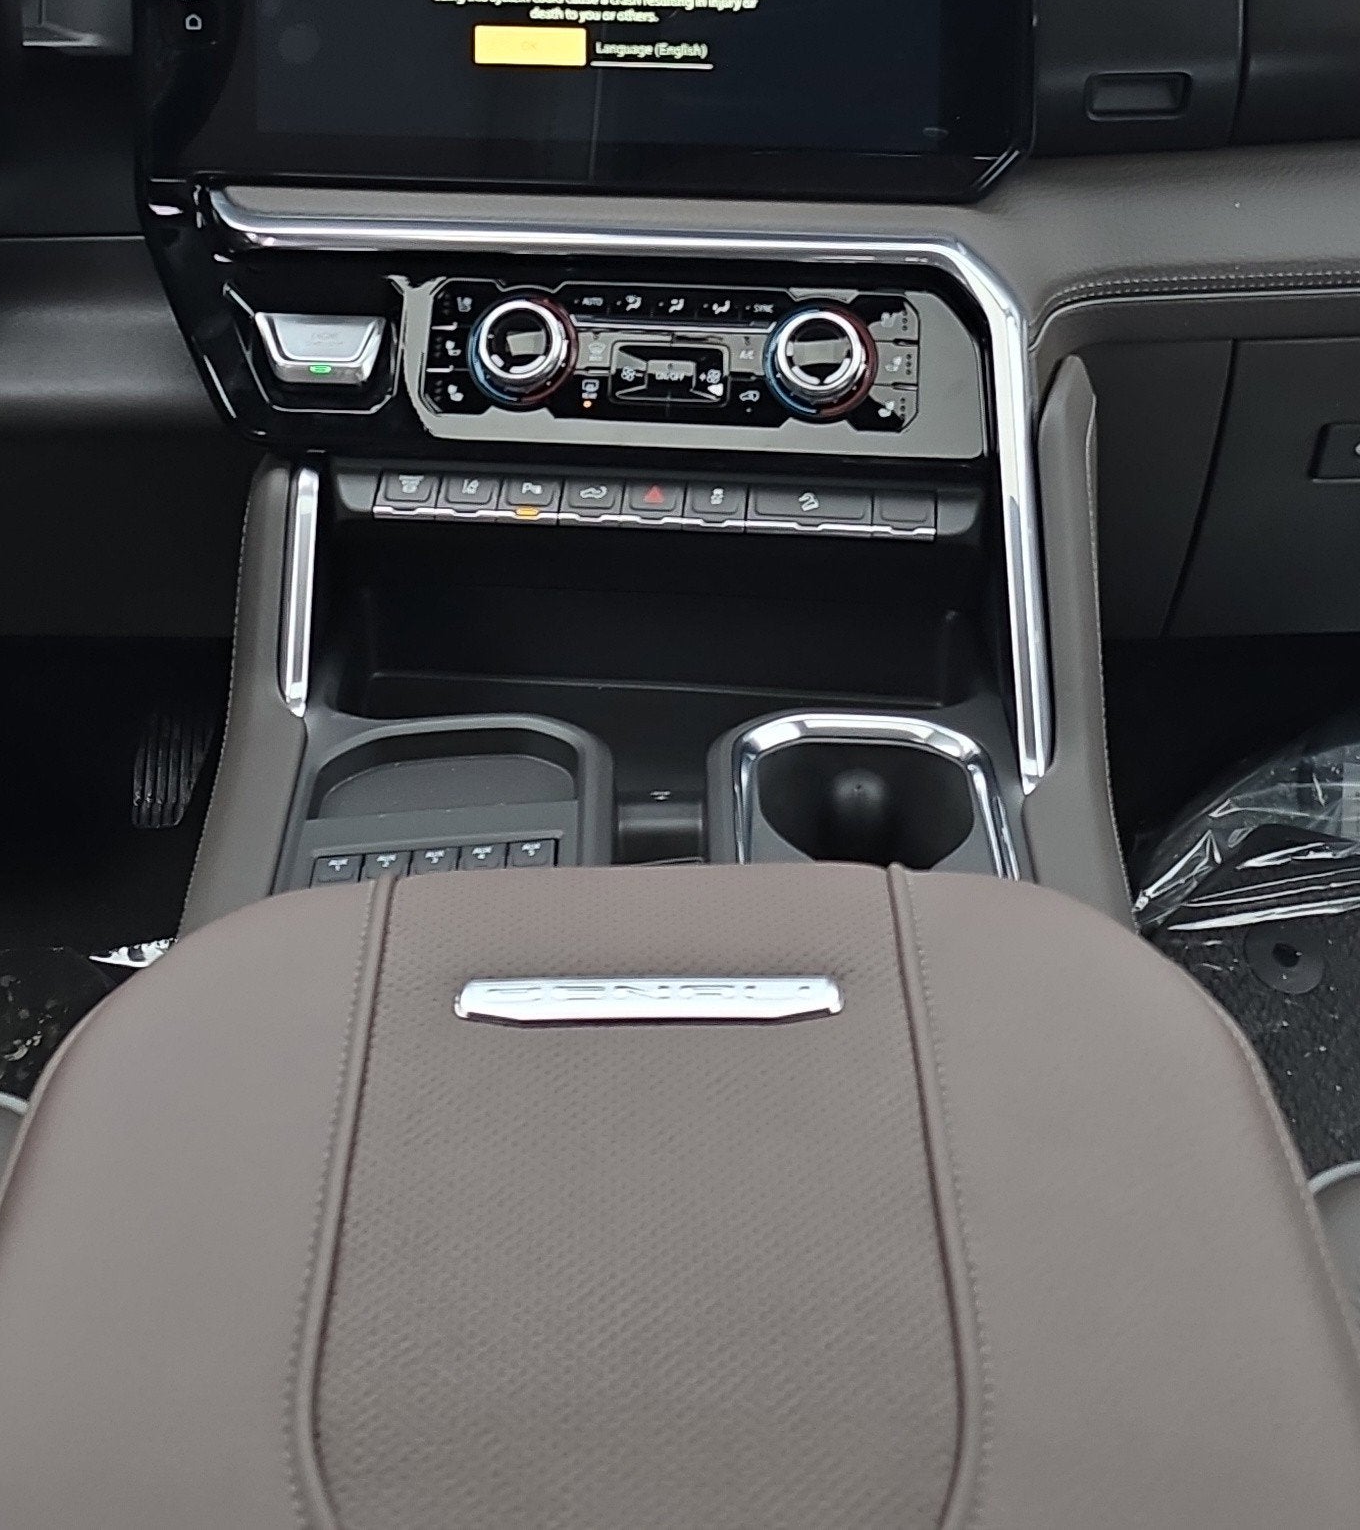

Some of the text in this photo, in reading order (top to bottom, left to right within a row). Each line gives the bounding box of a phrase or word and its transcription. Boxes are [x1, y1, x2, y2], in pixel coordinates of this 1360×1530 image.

[529, 6, 660, 23] death to you or others.
[595, 42, 708, 60] Language (English)
[582, 297, 604, 307] AUTO
[471, 845, 493, 854] AUX
[521, 842, 542, 851] AUX
[377, 853, 397, 862] AUX
[425, 850, 446, 858] AUX
[327, 858, 349, 867] AUX
